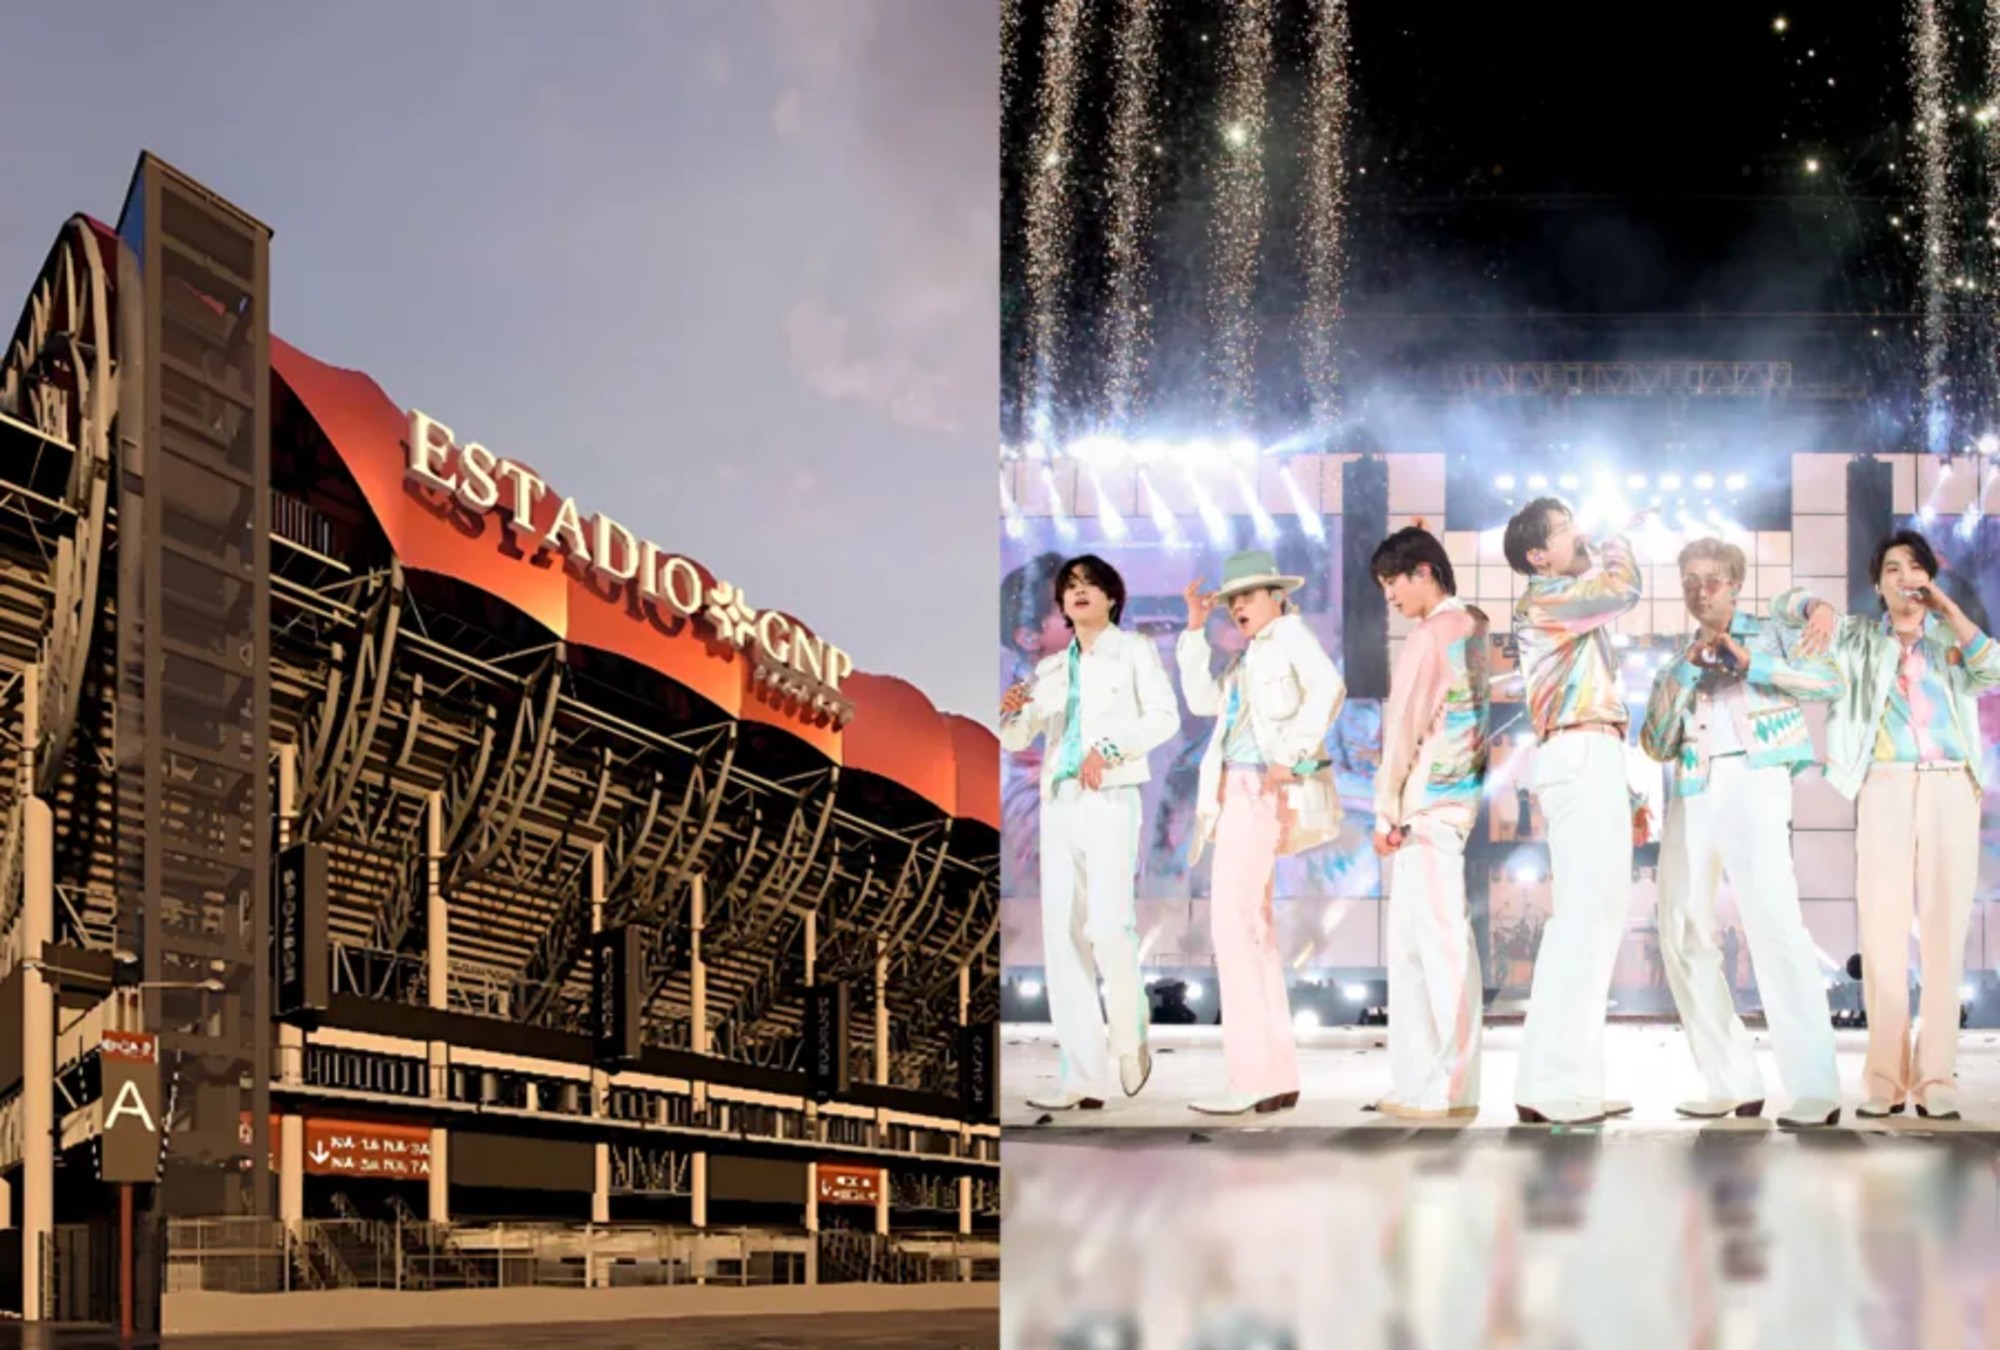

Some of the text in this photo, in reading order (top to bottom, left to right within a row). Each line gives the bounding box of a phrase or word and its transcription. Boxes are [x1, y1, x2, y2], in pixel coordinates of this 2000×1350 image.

[405, 408, 853, 692] ESTADIO GNP
[104, 1080, 156, 1132] A
